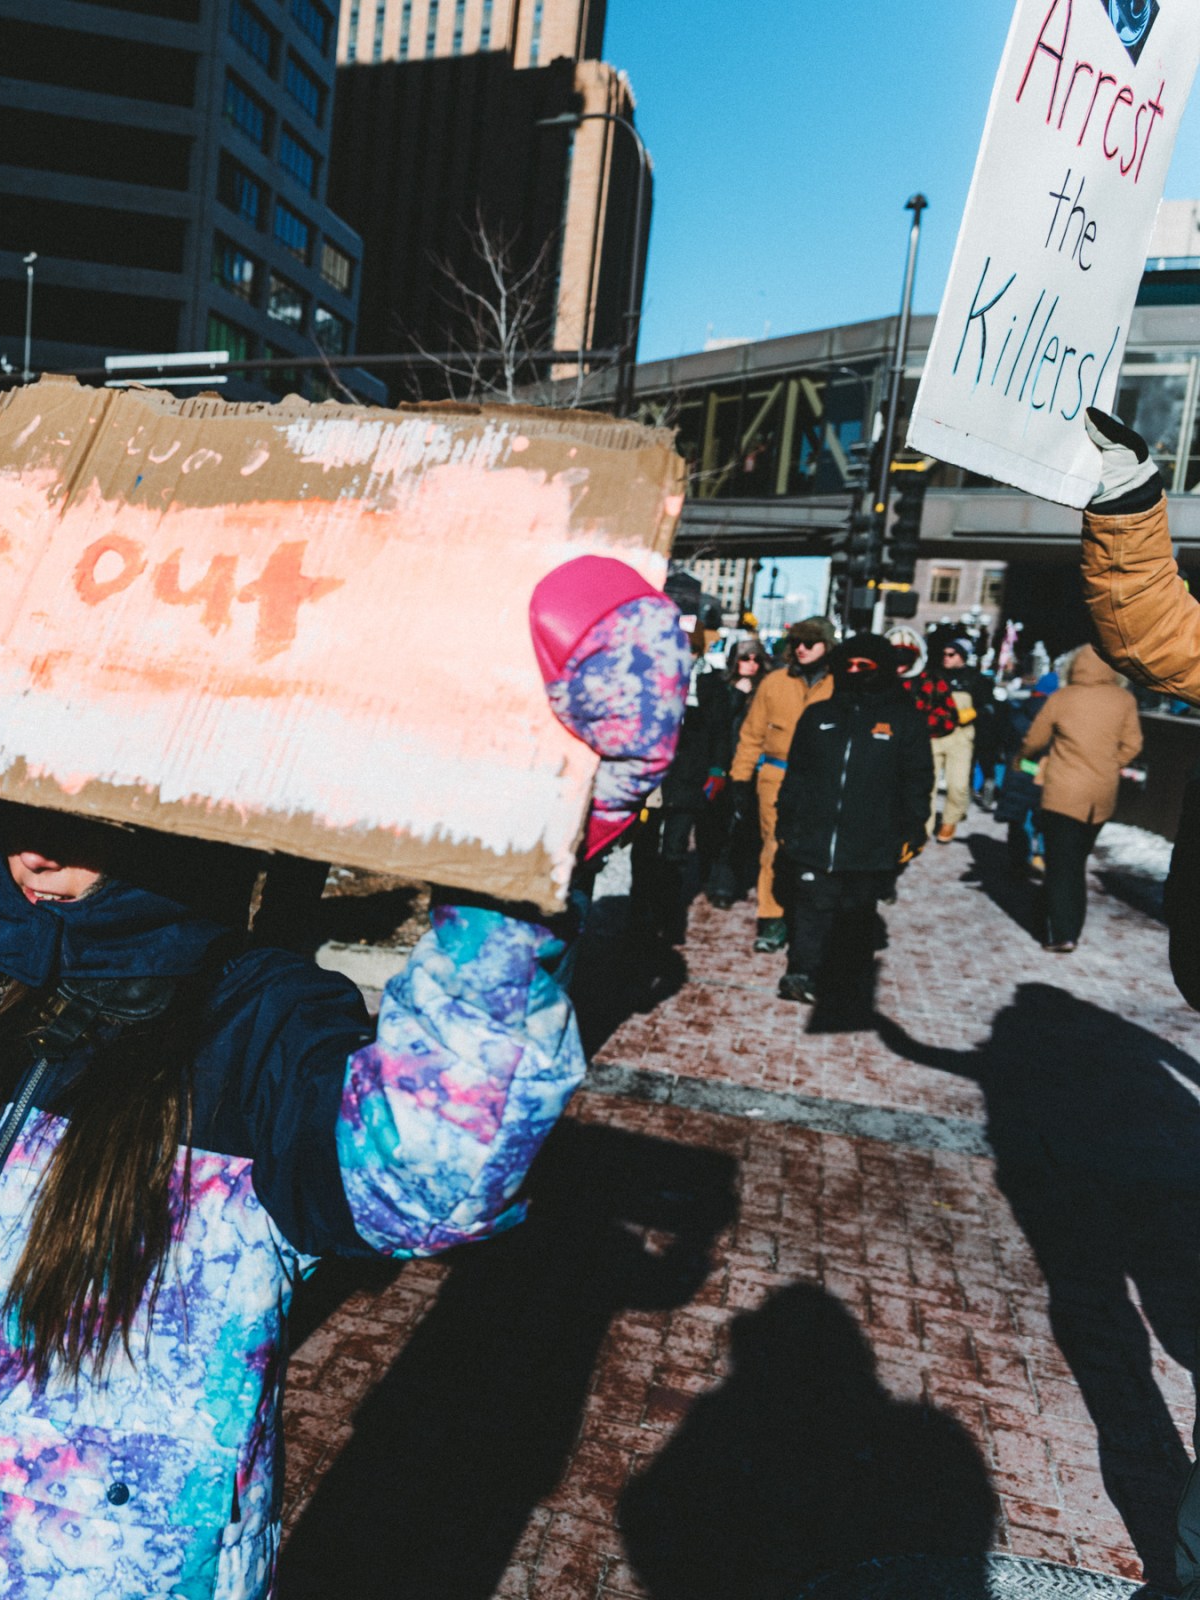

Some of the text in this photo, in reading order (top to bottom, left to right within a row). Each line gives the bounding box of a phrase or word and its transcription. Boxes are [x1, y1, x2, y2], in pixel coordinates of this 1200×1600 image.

[1015, 0, 1165, 184] Arrest
[1046, 168, 1097, 271] the
[952, 256, 1120, 421] Killers!
[71, 531, 347, 663] out
